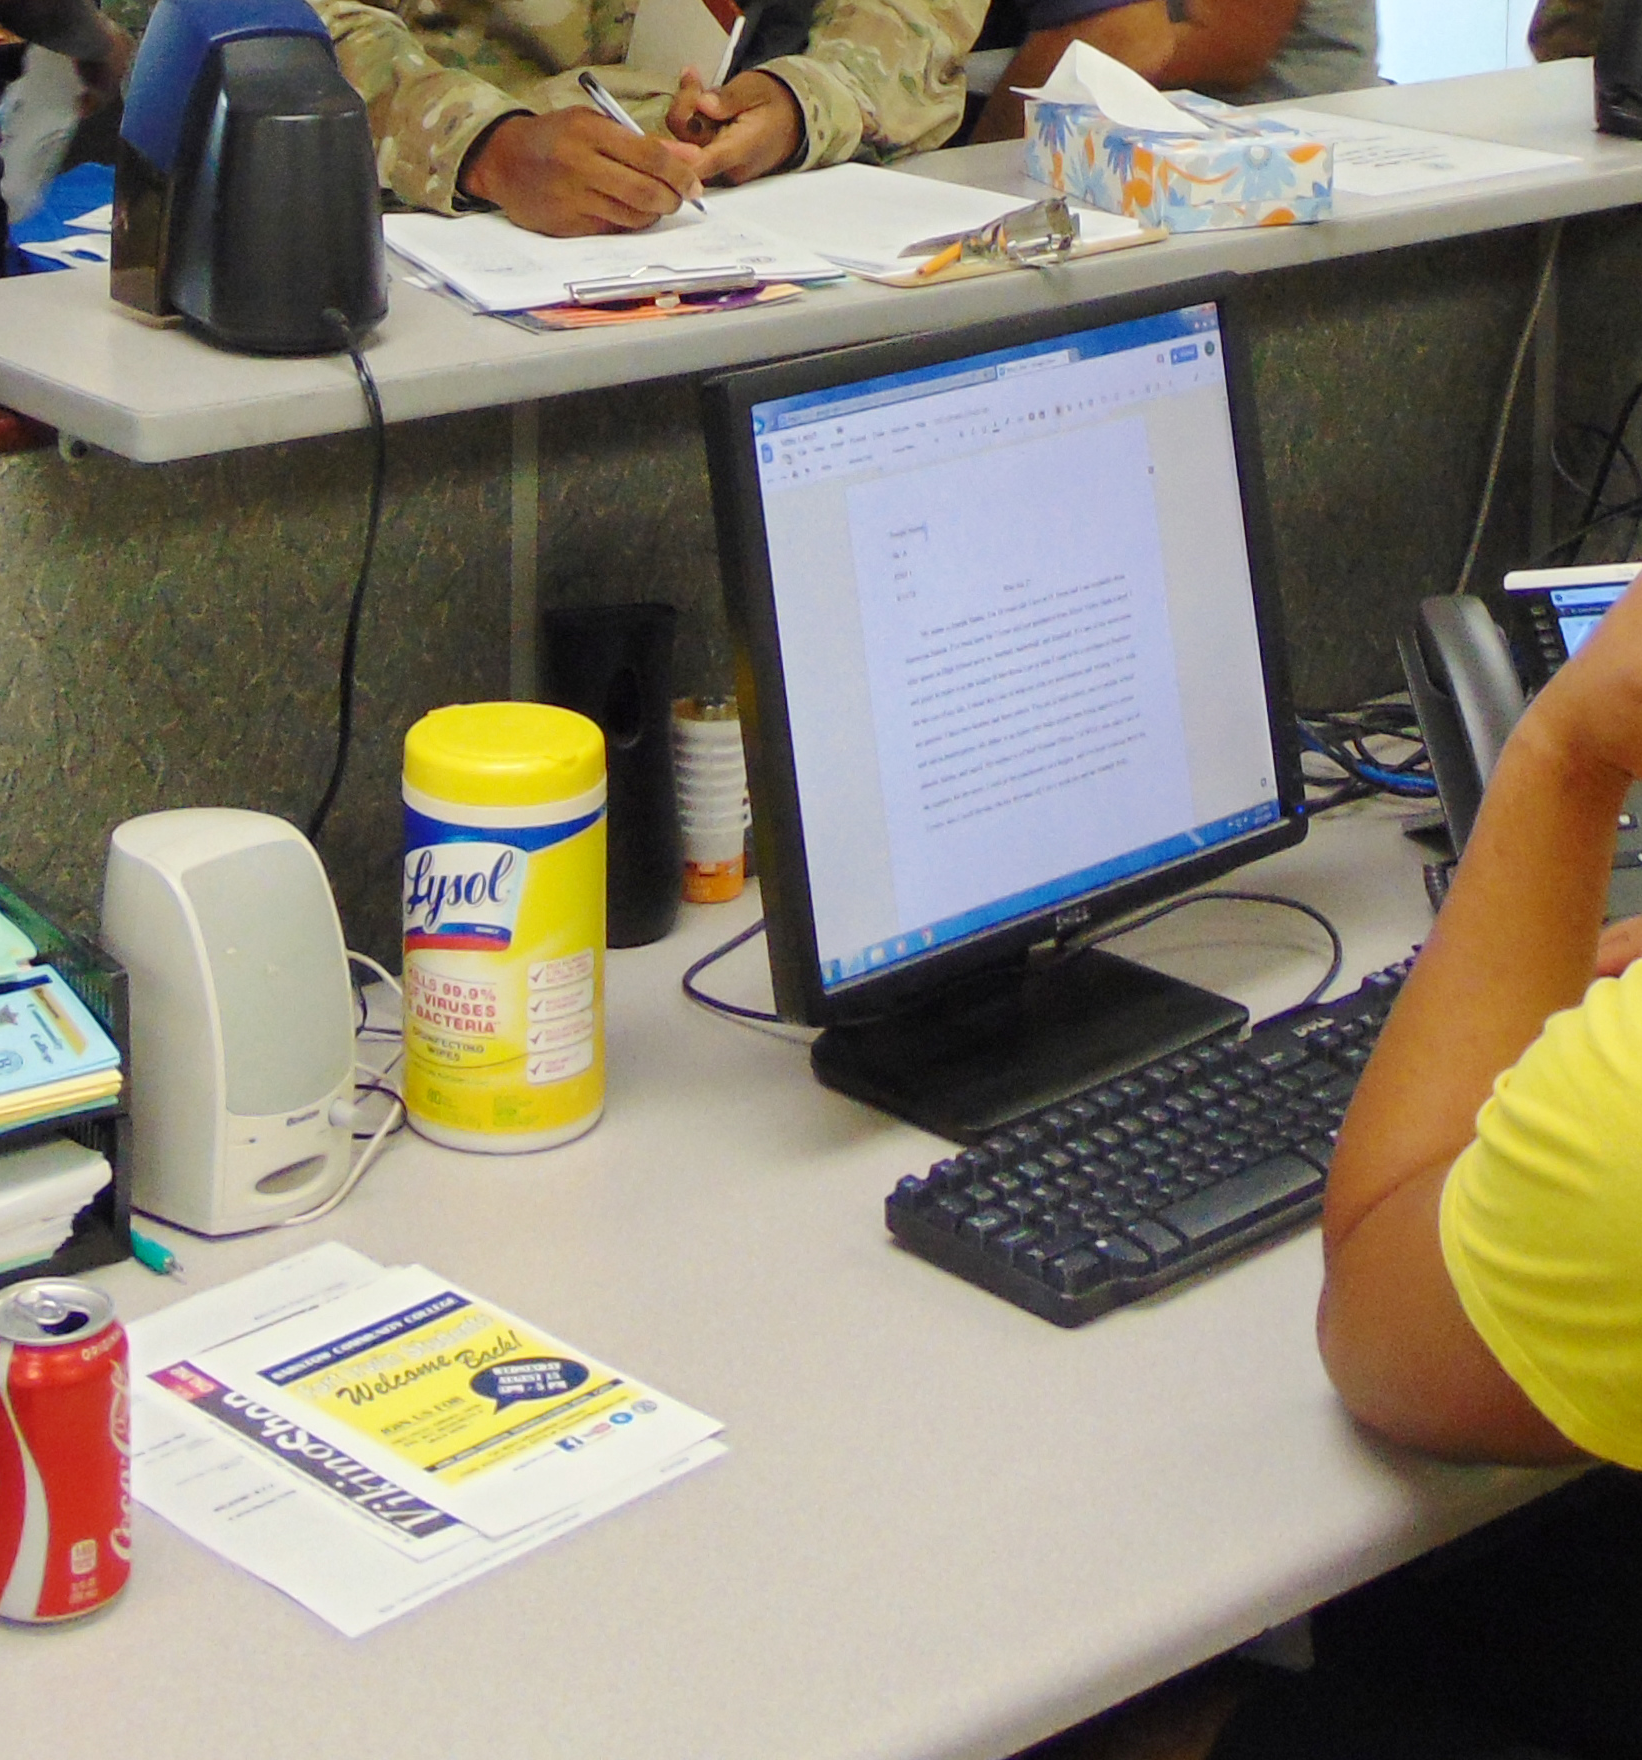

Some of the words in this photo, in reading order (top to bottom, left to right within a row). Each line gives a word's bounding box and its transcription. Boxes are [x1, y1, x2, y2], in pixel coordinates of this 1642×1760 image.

[407, 850, 514, 928] Lysol
[424, 991, 497, 1018] VIRUSES
[442, 982, 497, 1002] 99.9%
[416, 1005, 496, 1034] BACTERIA
[332, 1321, 405, 1356] COMMUNITY
[404, 1297, 457, 1326] COLLEGE
[335, 1354, 453, 1407] Welcome
[454, 1329, 523, 1370] Back!
